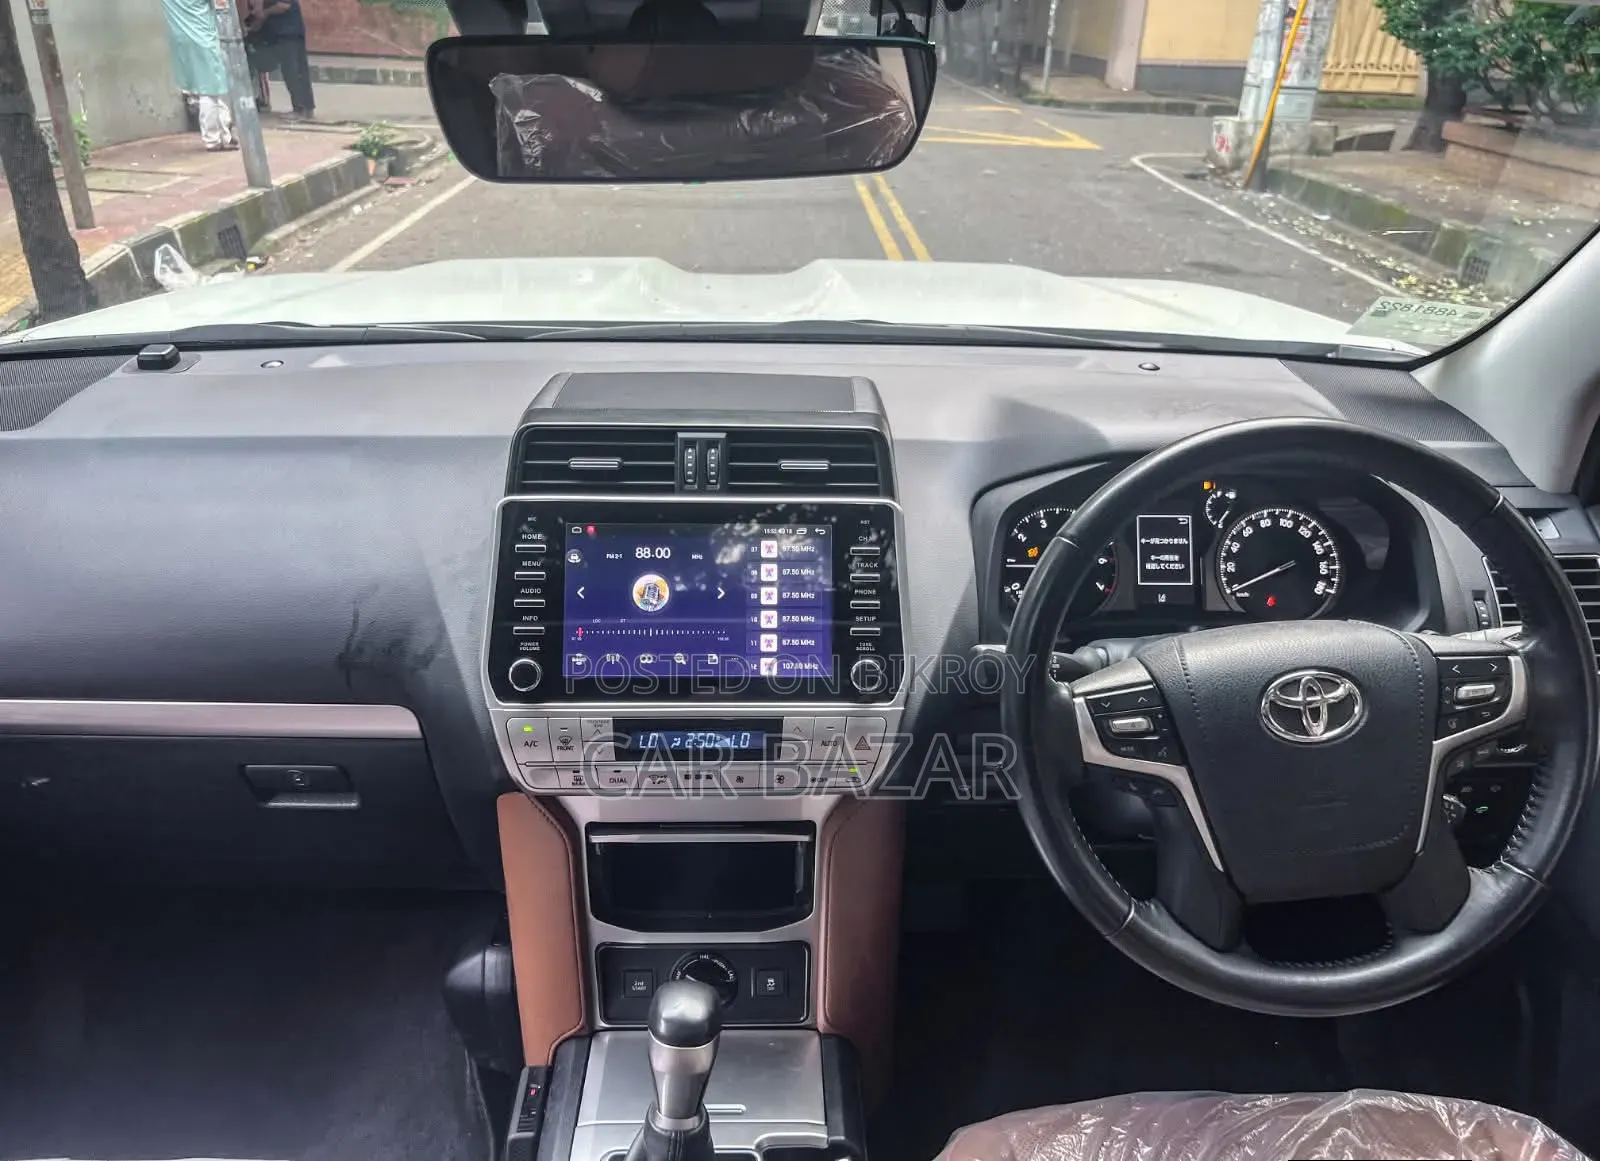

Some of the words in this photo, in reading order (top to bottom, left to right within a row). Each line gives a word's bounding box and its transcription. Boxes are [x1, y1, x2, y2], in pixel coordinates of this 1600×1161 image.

[1259, 518, 1272, 528] 80
[1279, 518, 1294, 528] 100
[1017, 533, 1027, 542] 2
[1039, 519, 1048, 528] 3
[1242, 526, 1254, 537] 60
[1298, 525, 1312, 538] 120
[1230, 541, 1240, 553] 40
[1312, 540, 1324, 555] 140
[635, 547, 671, 559] 88.00
[1226, 562, 1236, 573] 20
[1319, 561, 1328, 575] 160
[1011, 582, 1020, 591] 0
[1096, 582, 1105, 591] 7
[1314, 580, 1327, 595] 180
[524, 740, 539, 748] A/C
[639, 732, 659, 748] LO
[731, 732, 751, 748] LO
[821, 739, 838, 747] AUTO
